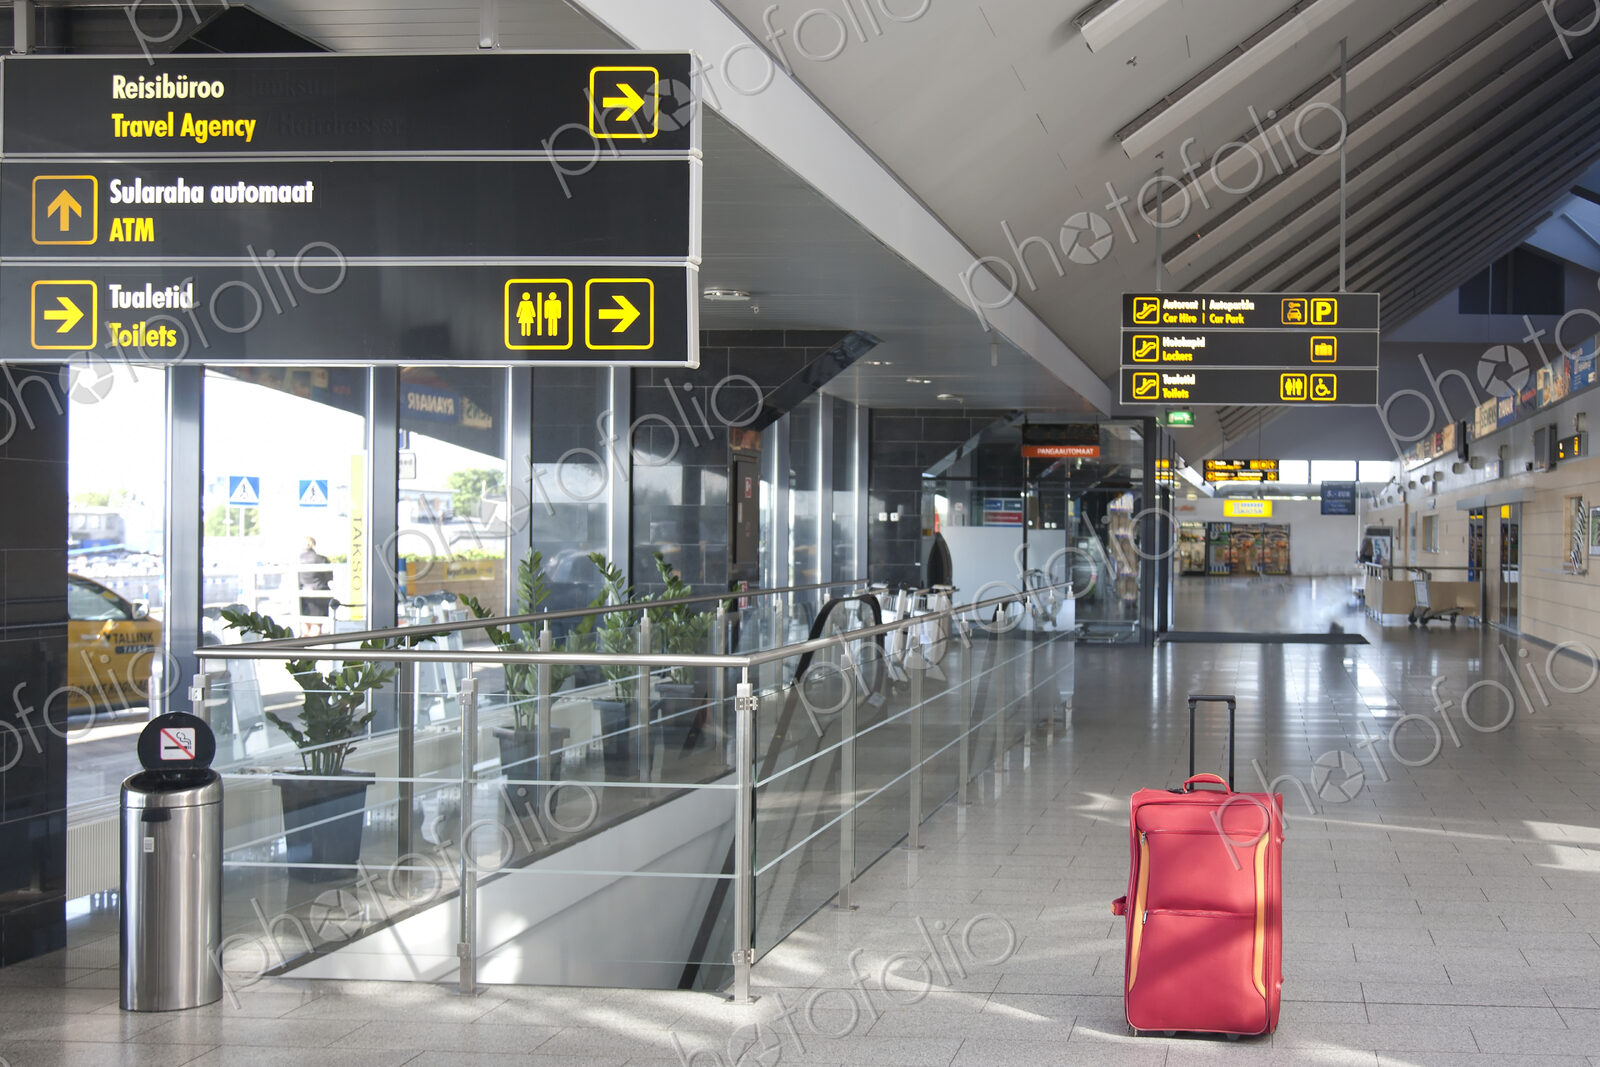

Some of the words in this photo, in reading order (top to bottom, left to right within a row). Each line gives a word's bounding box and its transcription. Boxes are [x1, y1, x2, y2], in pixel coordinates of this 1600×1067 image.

[112, 73, 224, 99] Reisibüroo
[111, 111, 173, 137] Travel
[180, 112, 256, 143] Agency
[109, 178, 204, 204] Sularaha
[210, 180, 314, 204] automaat
[109, 218, 154, 243] ATM
[109, 283, 193, 309] Tualetid
[1162, 313, 1178, 323] Car
[1179, 313, 1198, 323] Hire
[1209, 313, 1224, 324] Car
[1225, 313, 1245, 324] Park
[109, 322, 177, 347] Toilets
[1162, 350, 1193, 361] Lockers
[1162, 388, 1190, 399] Toilets
[352, 516, 363, 592] TAKSO
[113, 632, 153, 644] TALLINK
